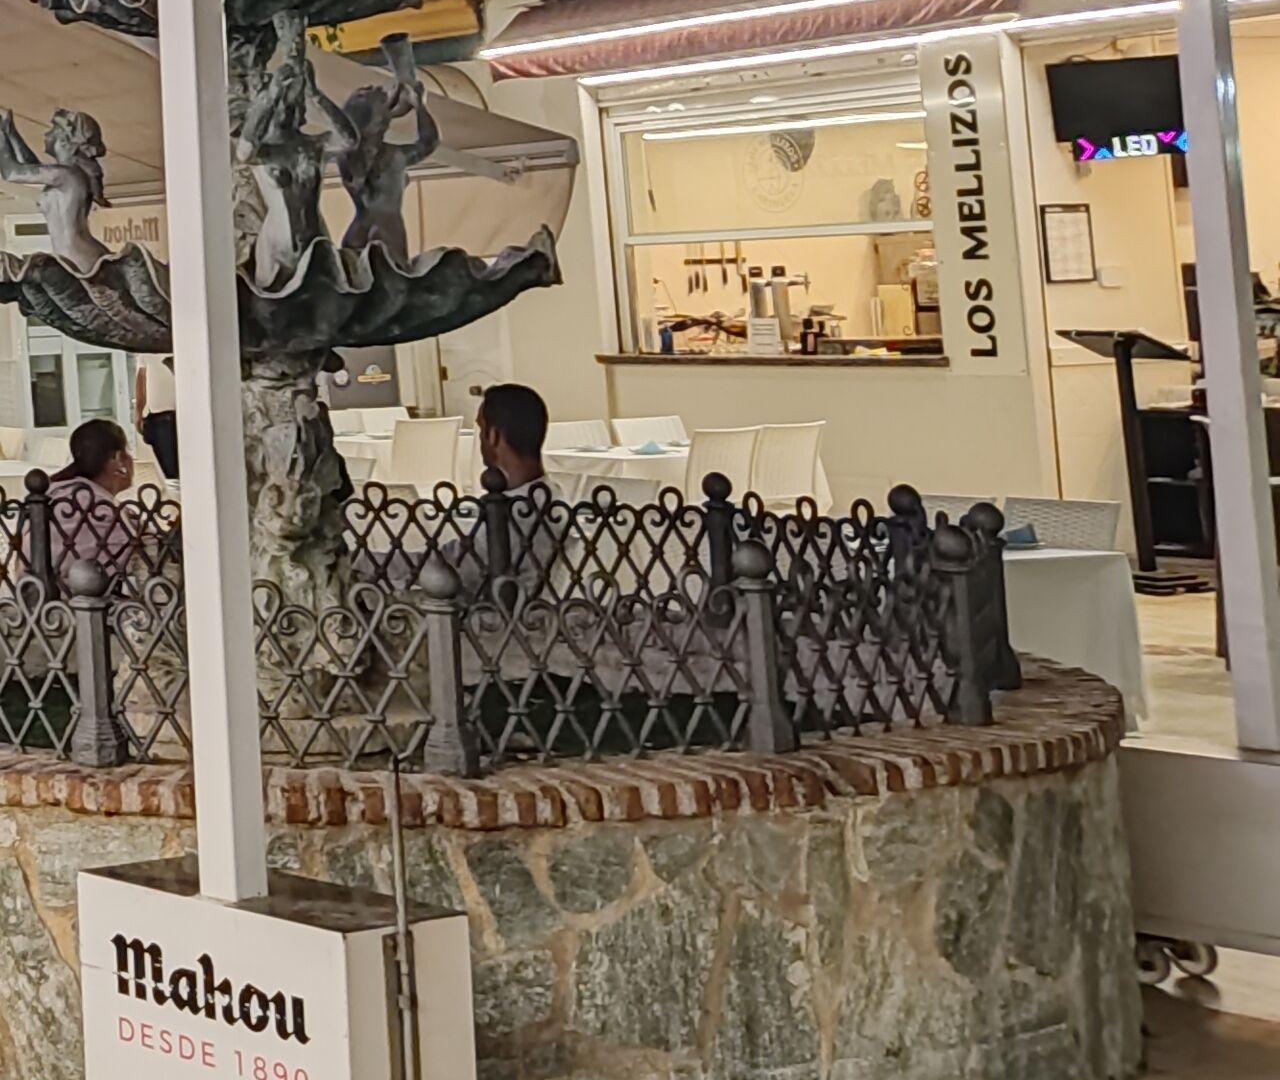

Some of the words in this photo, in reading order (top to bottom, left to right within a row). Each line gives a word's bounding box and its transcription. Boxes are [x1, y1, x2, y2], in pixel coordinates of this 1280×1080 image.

[943, 52, 990, 260] MELLIZOS
[1111, 133, 1159, 157] LED
[964, 278, 999, 358] LOS
[109, 933, 312, 1045] Mahou
[118, 1016, 216, 1068] DESDE
